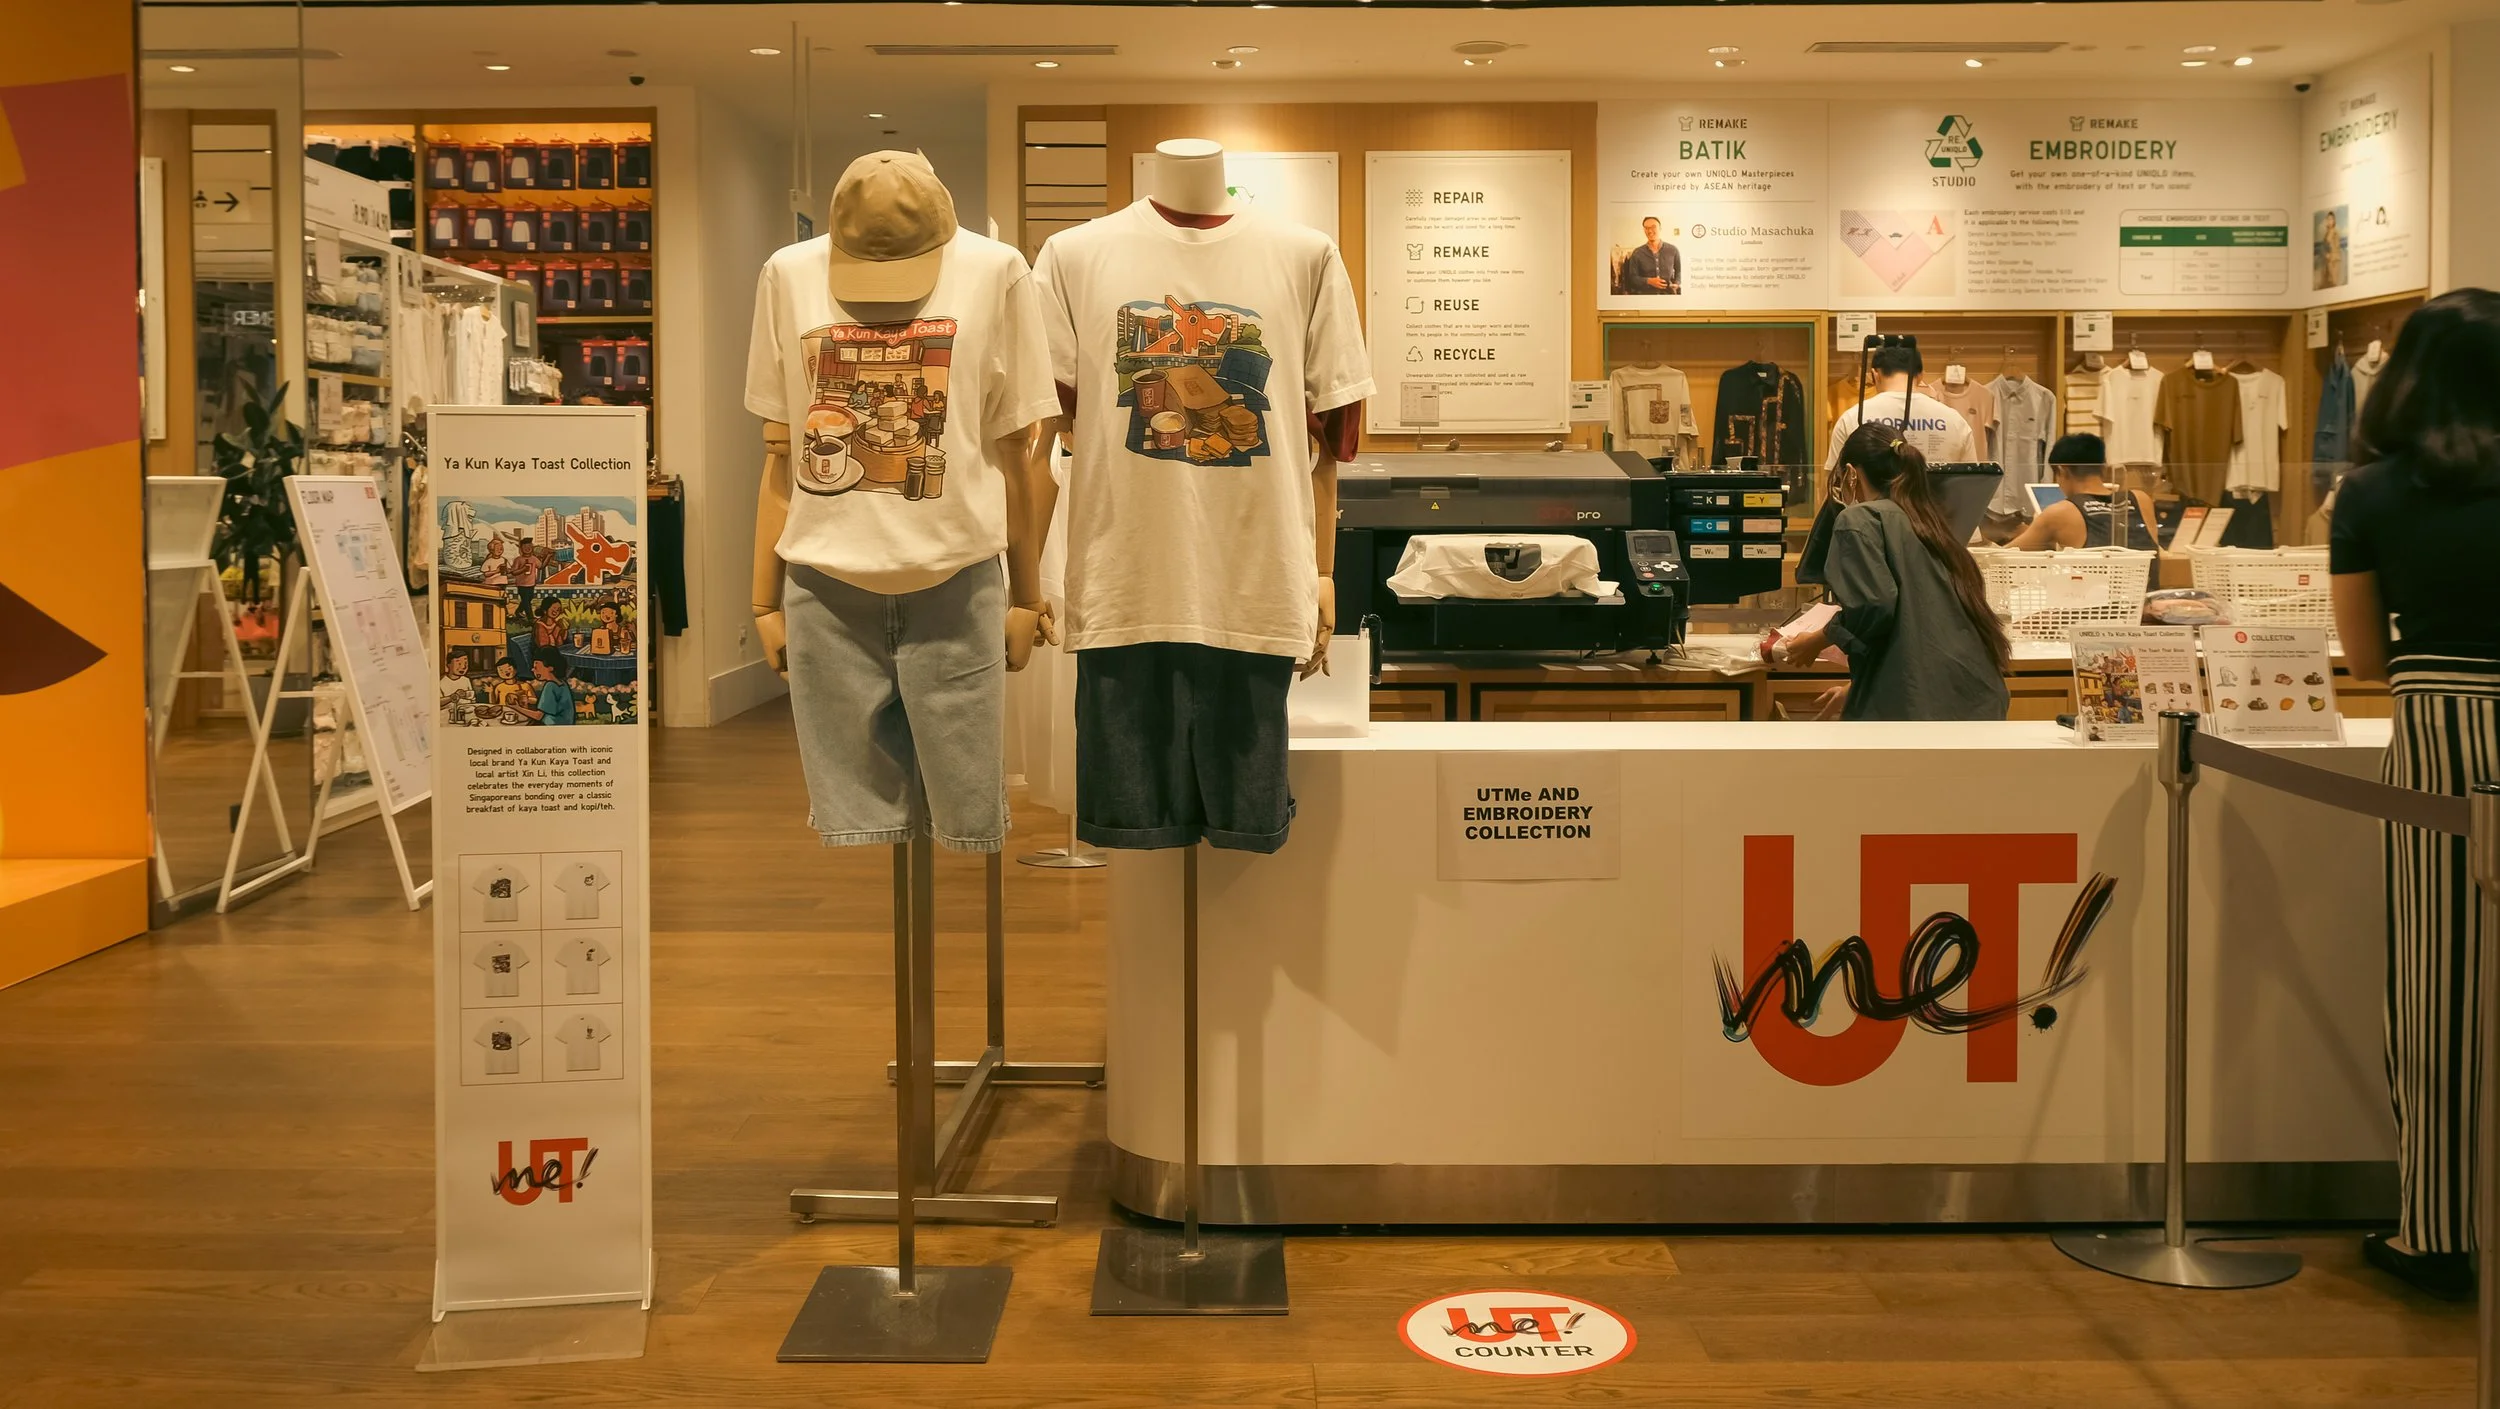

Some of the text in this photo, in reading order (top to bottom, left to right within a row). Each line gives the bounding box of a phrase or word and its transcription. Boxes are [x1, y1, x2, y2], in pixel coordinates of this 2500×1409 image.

[1700, 119, 1747, 129] REMAKE
[2090, 119, 2138, 129] REMAKE
[2320, 108, 2399, 153] EMBROIDERY
[1679, 141, 1746, 160] BATIK
[2030, 141, 2177, 160] EMBROIDERY
[1631, 170, 1658, 178] Create
[1663, 171, 1680, 180] your
[1706, 170, 1737, 178] UNIQLO
[1742, 170, 1794, 179] Masterpieces
[2011, 170, 2024, 178] Get
[2028, 171, 2046, 179] your
[2072, 170, 2132, 178] one-of-a-kind
[2137, 170, 2168, 178] UNIQLO
[1654, 183, 1686, 191] inspired
[1690, 183, 1699, 191] by
[1738, 183, 1771, 191] heritage
[1933, 177, 1976, 187] STUDIO
[2054, 183, 2101, 192] embroidery
[1434, 192, 1484, 203] REPAIR
[1711, 227, 1814, 236] Studio Masachuka
[1434, 246, 1489, 257] REMAKE
[1434, 299, 1479, 311] REUSE
[831, 321, 954, 345] Ya Kun Kaya Toast
[1434, 349, 1495, 360] RECYCLE
[444, 458, 631, 473] Ya Kun Kaya Toast Collection
[1577, 510, 1601, 521] pro
[468, 748, 502, 757] Designed
[591, 745, 612, 753] iconic
[470, 757, 611, 767] local brand Ya Kun Kaya Toast and
[468, 782, 508, 790] celebrates
[528, 782, 563, 790] everyday
[470, 794, 521, 803] Singaporeans
[525, 793, 554, 801] bonding
[587, 791, 611, 799] classic
[1477, 787, 1580, 801] UTMe AND
[467, 805, 503, 813] breakfast
[519, 805, 537, 813] kaya
[1463, 806, 1593, 820] EMBROIDERY
[1465, 825, 1591, 839] COLLECTION
[1708, 871, 2119, 1043] me!
[1743, 833, 2078, 1087] UT
[491, 1147, 599, 1195] me!
[498, 1138, 588, 1206] UT
[1441, 1312, 1586, 1336] me!
[1446, 1307, 1571, 1343] UT
[1455, 1346, 1594, 1357] COUNTER
